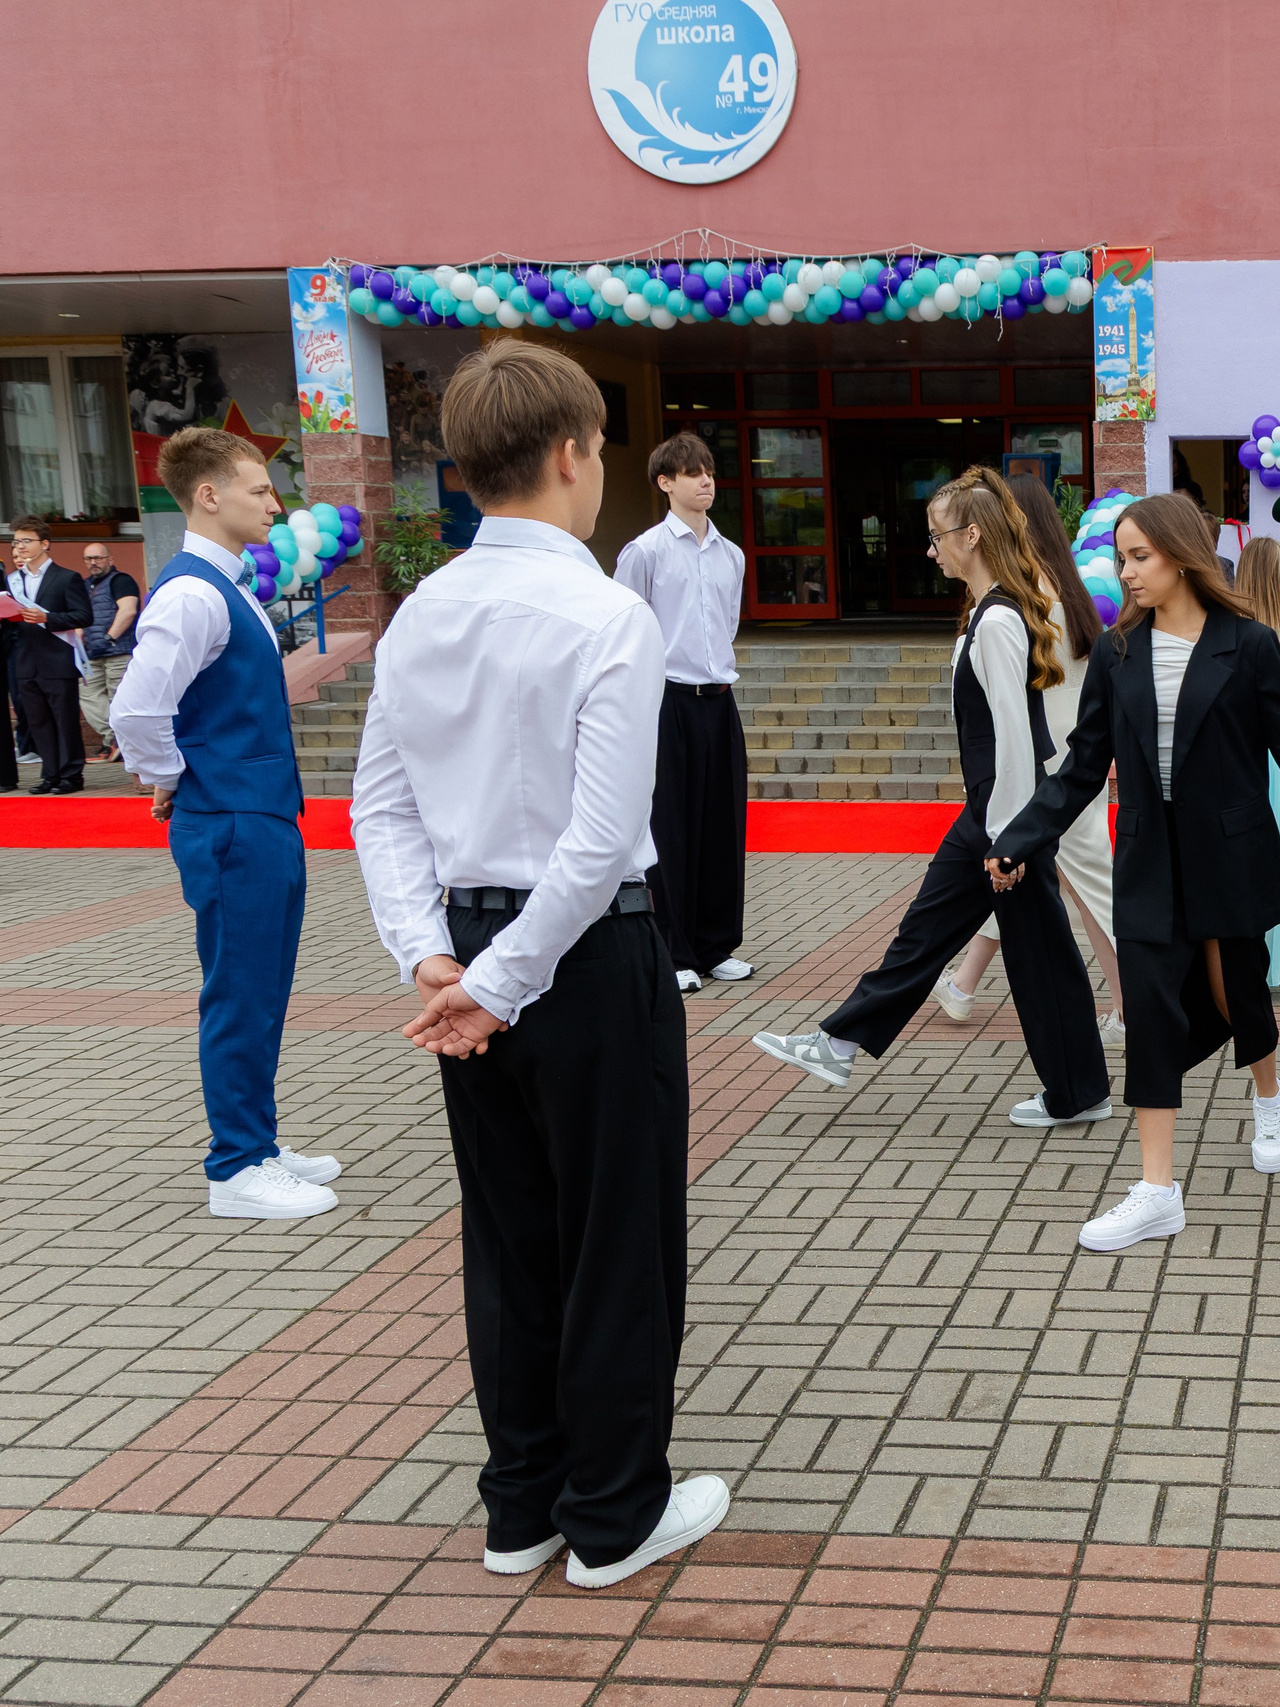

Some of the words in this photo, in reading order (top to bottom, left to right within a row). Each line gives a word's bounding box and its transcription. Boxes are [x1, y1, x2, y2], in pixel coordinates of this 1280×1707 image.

[614, 2, 654, 23] ГУО
[655, 4, 717, 21] СРЕДНЯЯ
[656, 24, 735, 44] школа
[718, 52, 777, 103] 49
[715, 93, 733, 109] №
[310, 274, 327, 297] 9
[1098, 324, 1125, 337] 1941
[1098, 343, 1126, 356] 1945
